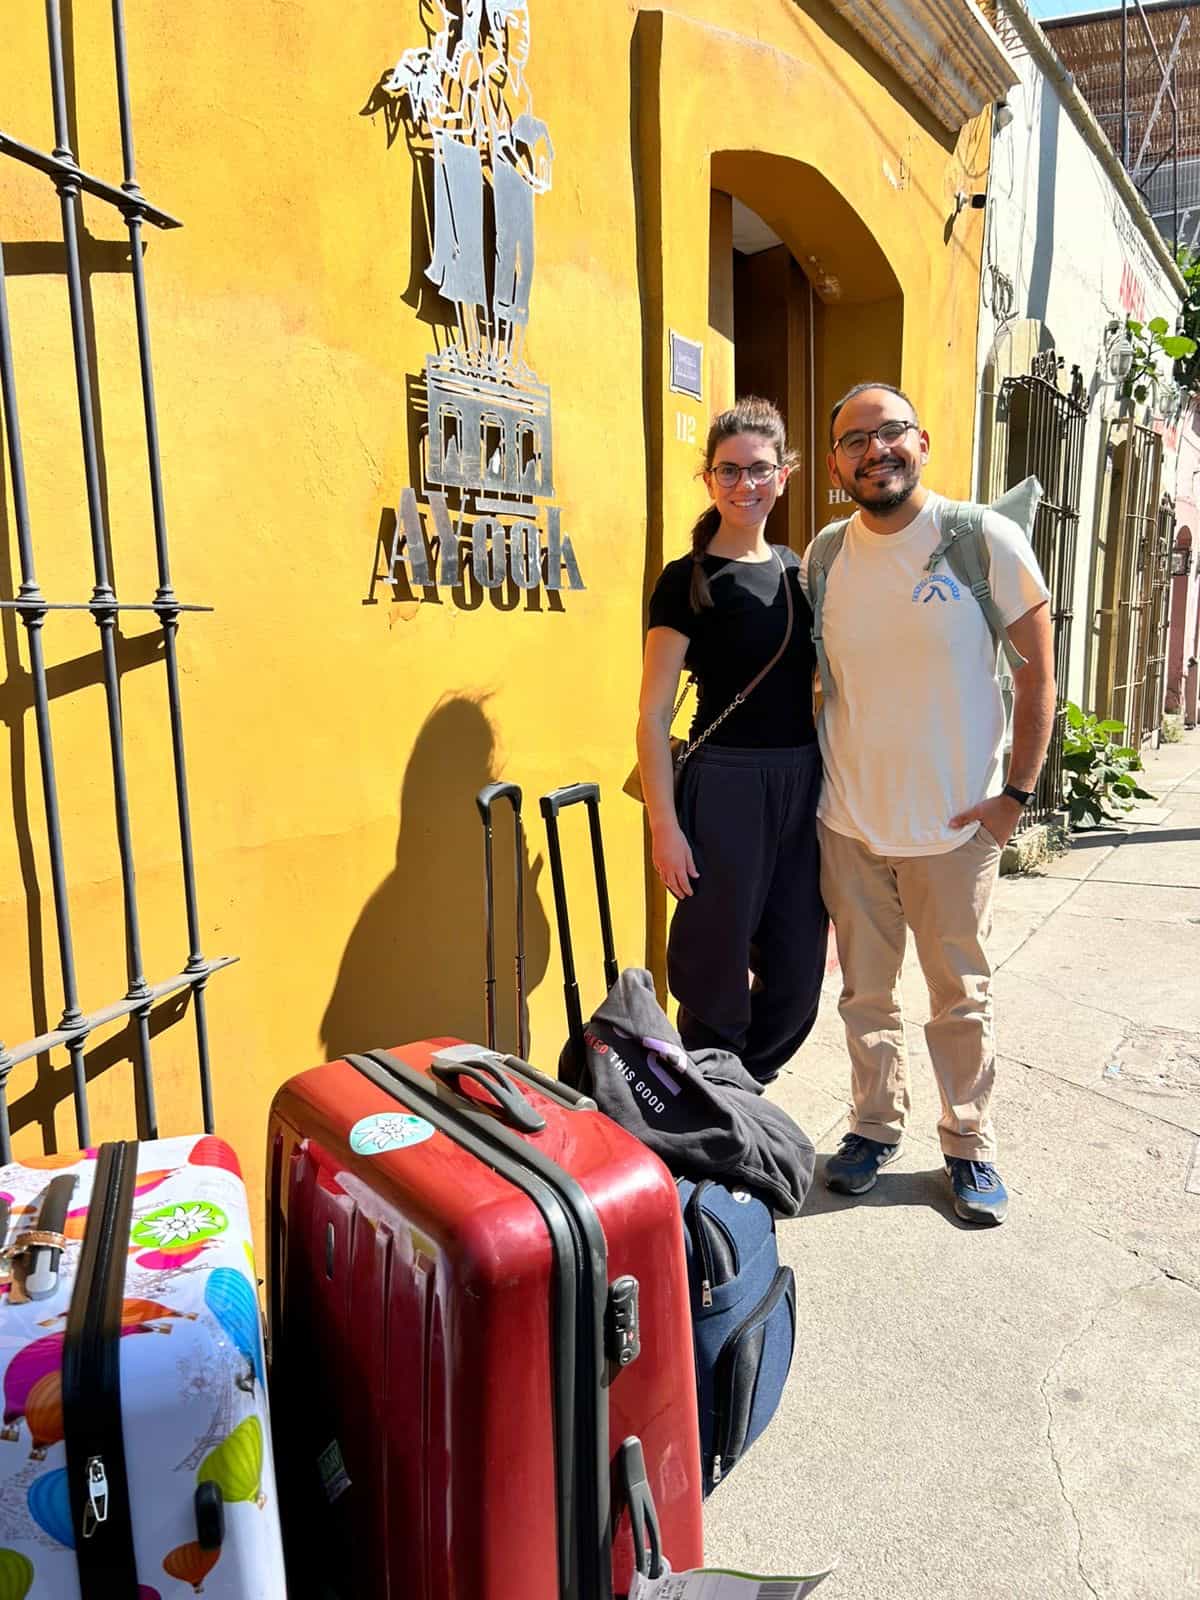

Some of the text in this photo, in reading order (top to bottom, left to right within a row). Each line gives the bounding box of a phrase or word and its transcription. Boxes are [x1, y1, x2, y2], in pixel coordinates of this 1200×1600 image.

[676, 411, 696, 444] 112
[609, 1052, 636, 1081] THIS
[635, 1080, 665, 1113] GOOD
